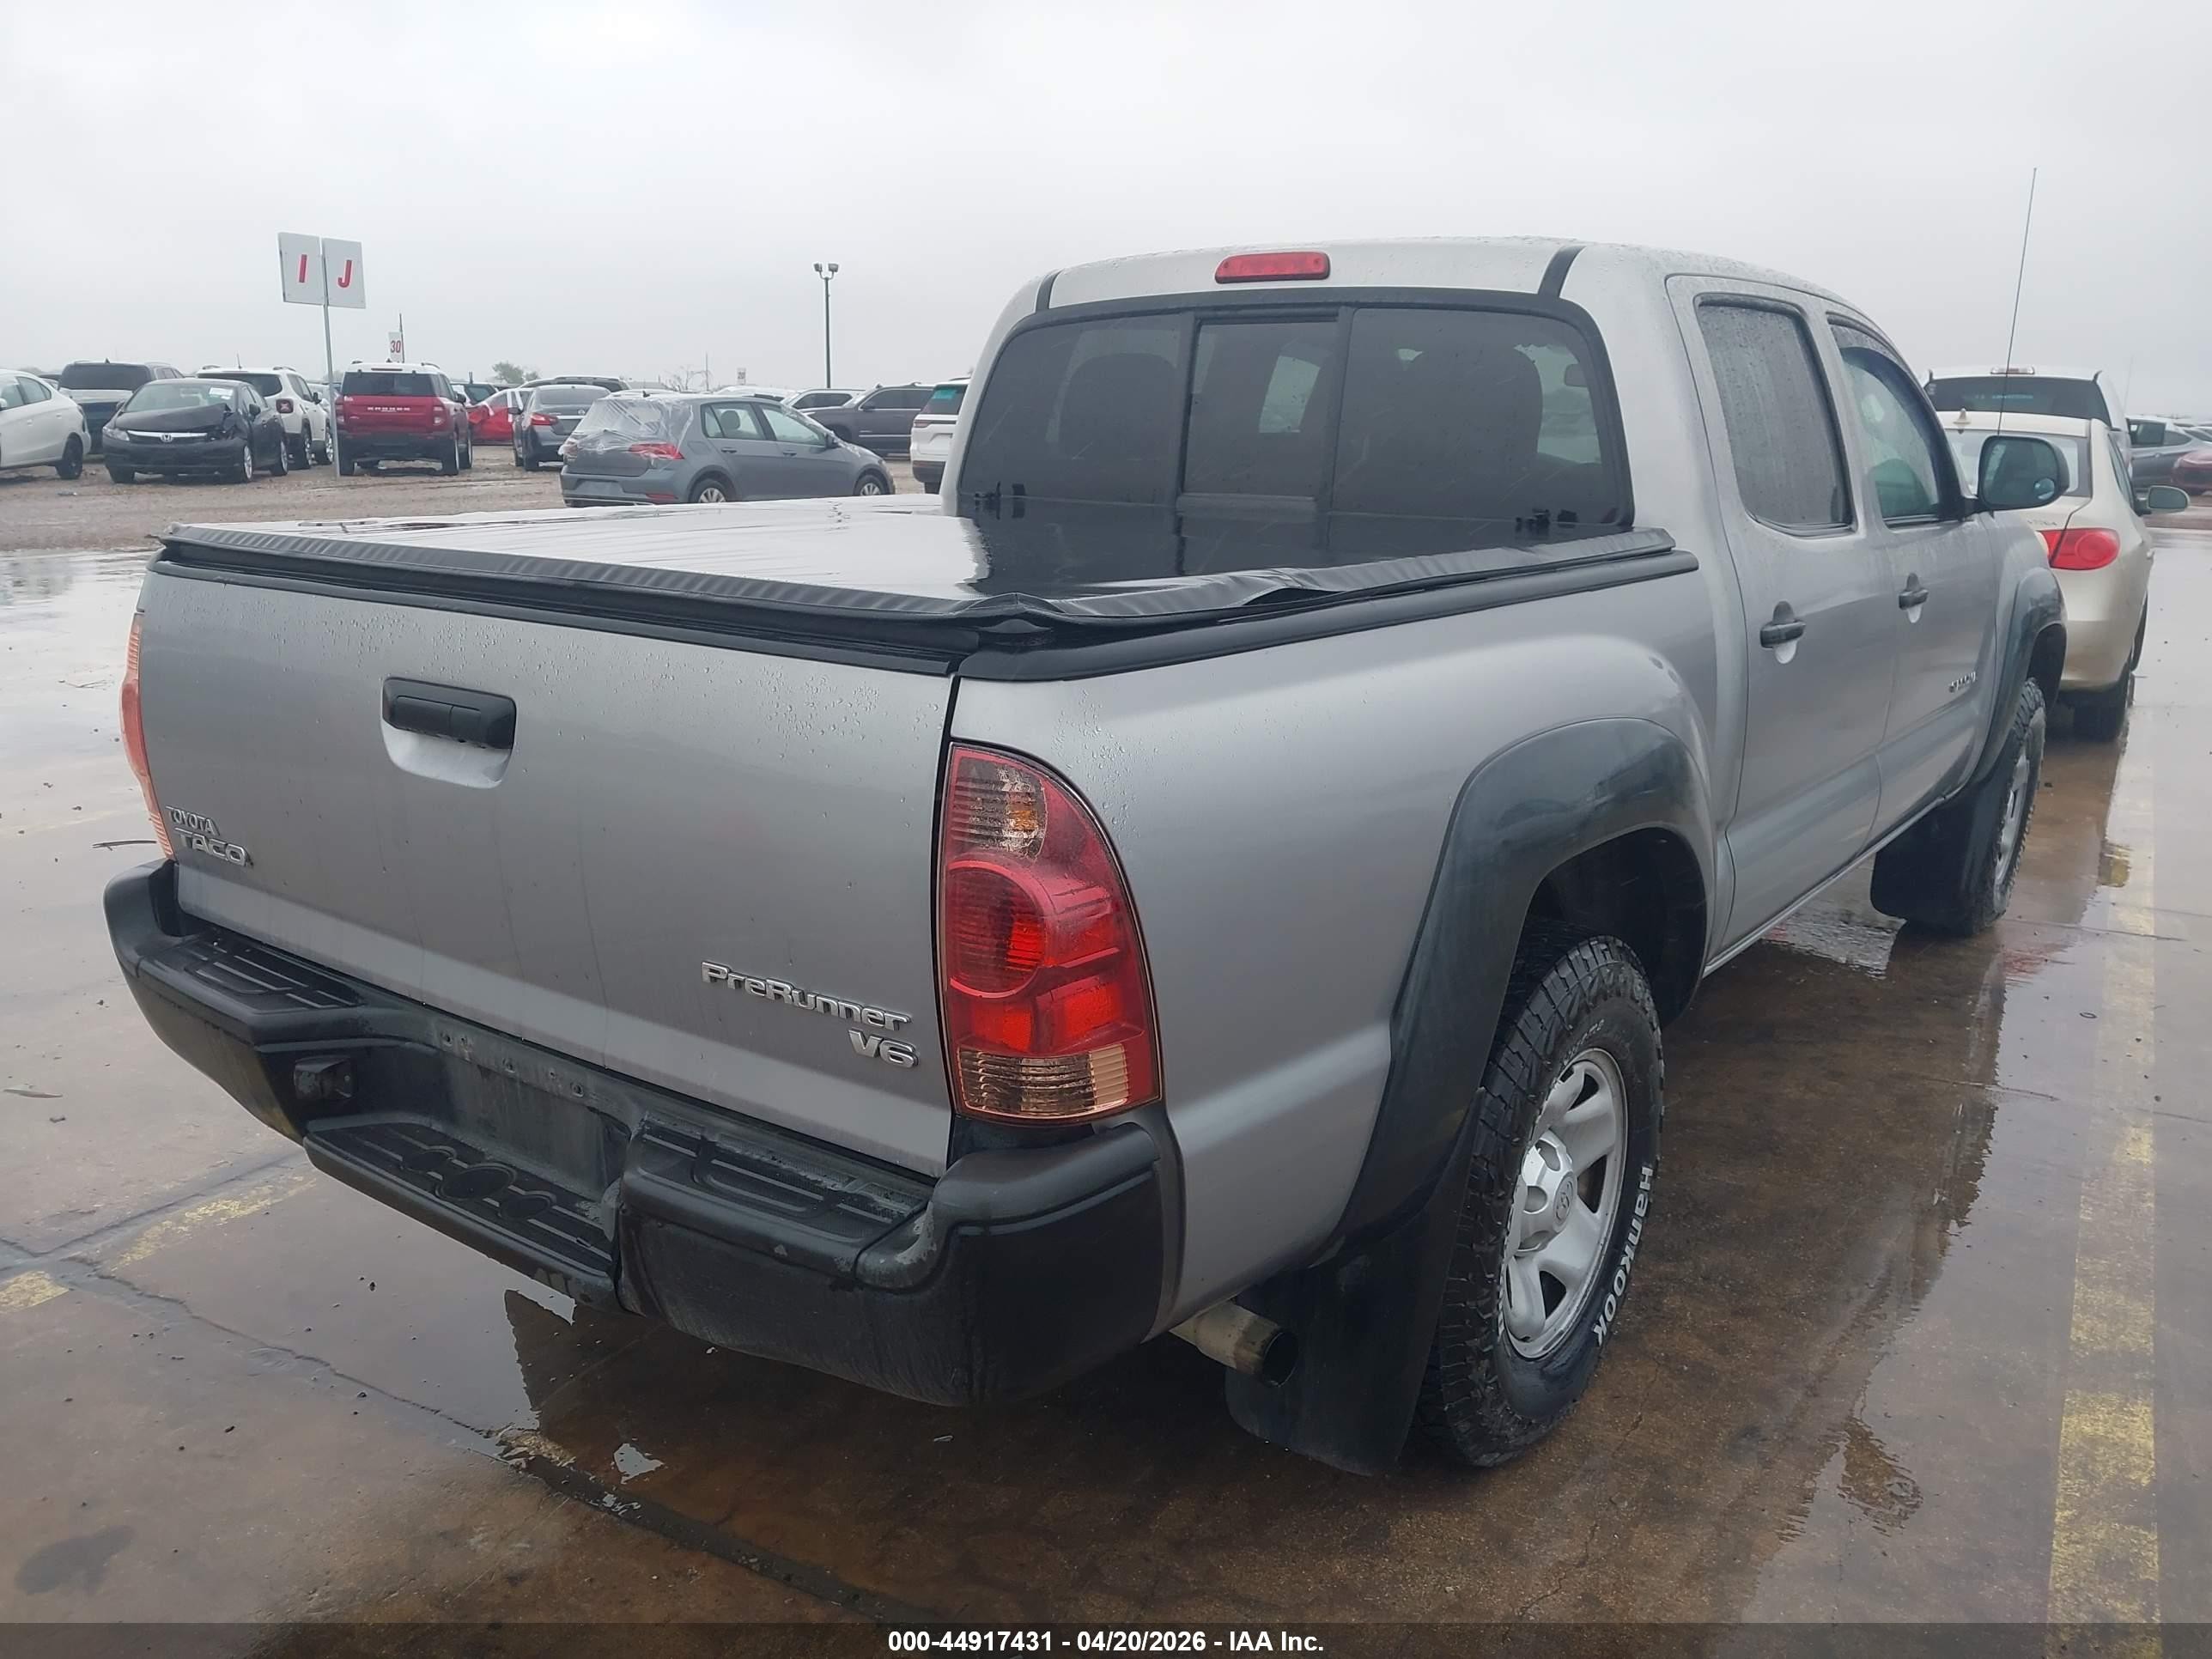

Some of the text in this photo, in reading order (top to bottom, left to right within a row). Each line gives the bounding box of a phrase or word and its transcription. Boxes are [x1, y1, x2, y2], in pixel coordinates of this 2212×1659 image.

[299, 254, 307, 283] I
[337, 259, 352, 288] J
[390, 340, 401, 353] 30
[166, 805, 218, 836] TOYOTA
[174, 827, 246, 866] TACO
[702, 960, 912, 1031] PreRunner
[848, 1027, 920, 1068] V6
